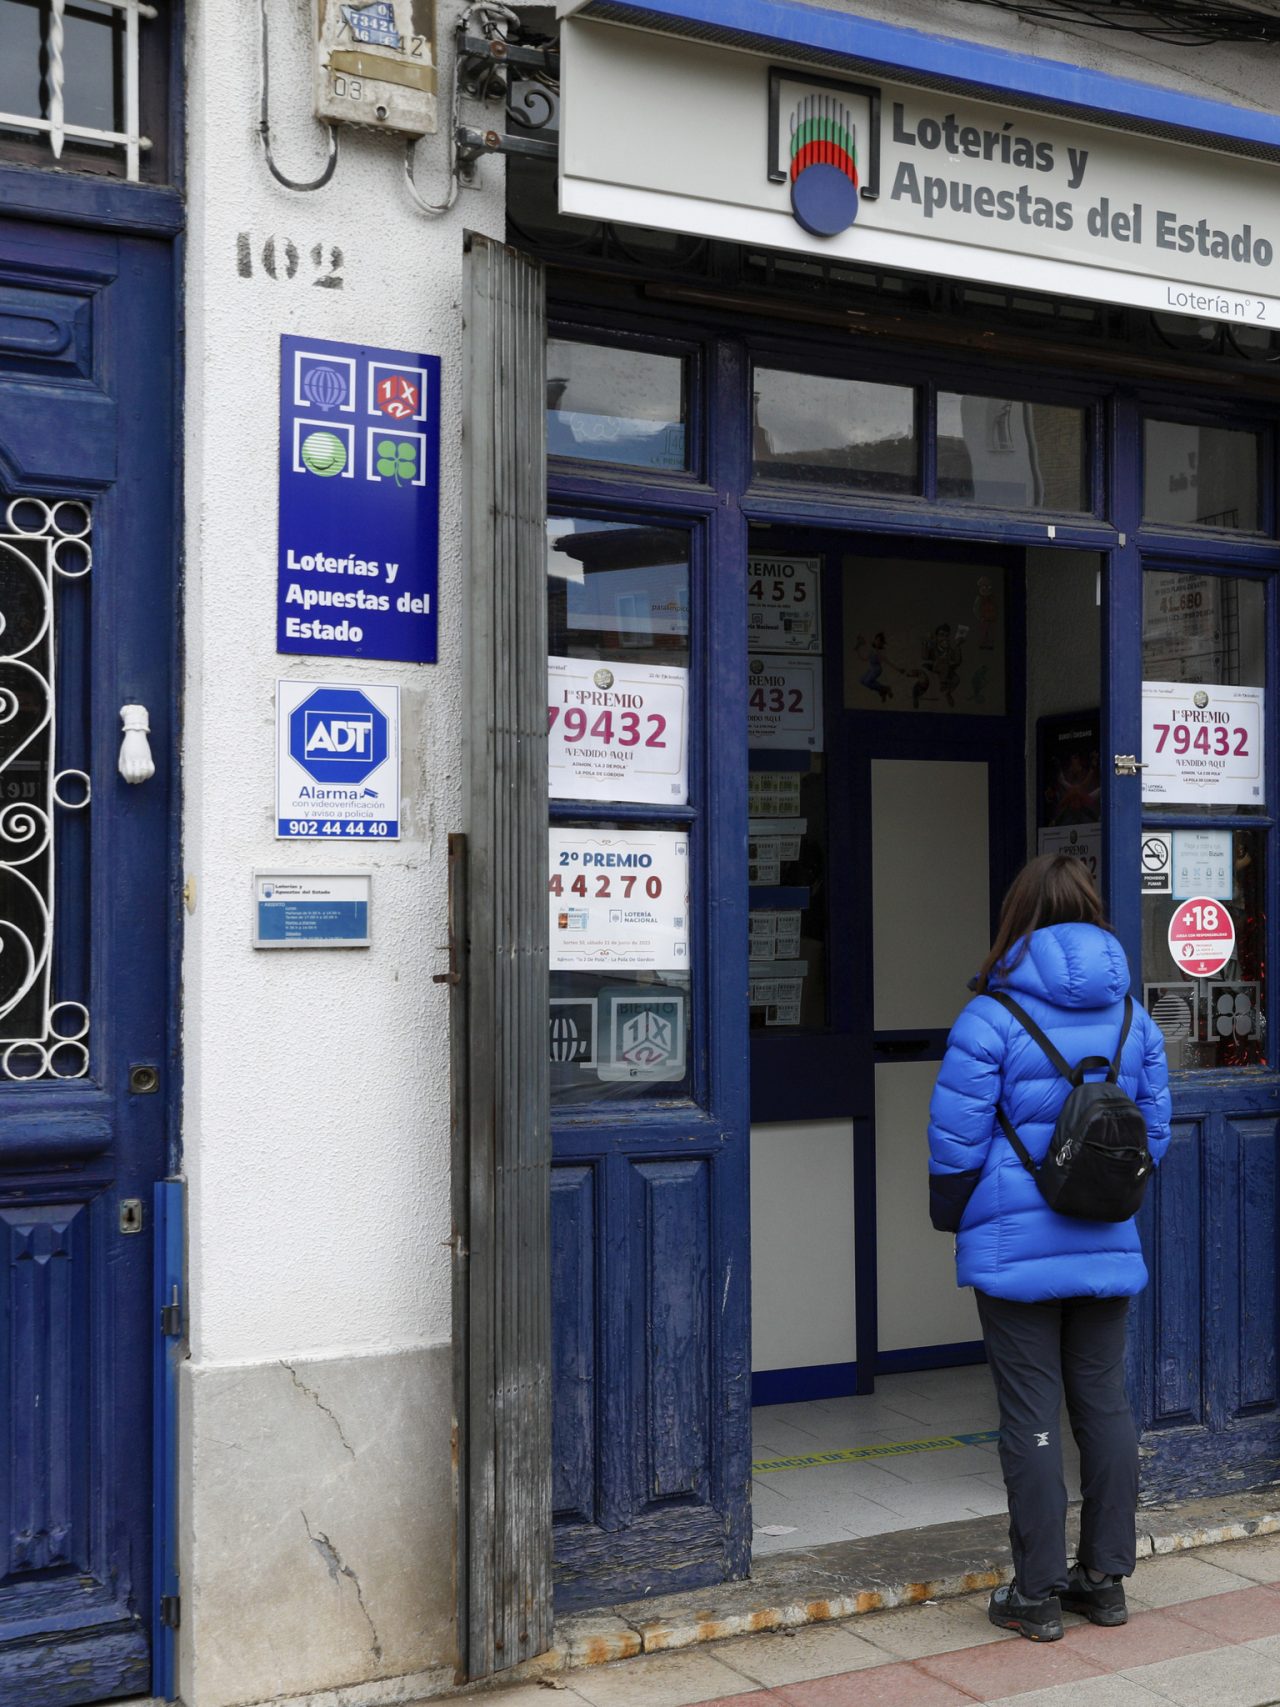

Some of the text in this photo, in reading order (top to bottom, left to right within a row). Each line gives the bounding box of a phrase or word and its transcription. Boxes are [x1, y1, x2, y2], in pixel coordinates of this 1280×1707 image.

[335, 77, 361, 100] 03
[893, 102, 1089, 189] Loterías y
[890, 161, 1273, 267] Apuestas del Estado
[236, 232, 344, 290] 102
[1167, 286, 1230, 315] Lotería
[1256, 300, 1266, 320] 2
[287, 549, 399, 584] Loterías y
[285, 584, 430, 614] Apuestas del
[286, 617, 363, 642] Estado
[576, 690, 643, 709] PREMIO
[548, 706, 666, 748] 79432
[1181, 710, 1230, 724] PREMIO
[306, 720, 371, 753] ADT
[1153, 724, 1249, 757] 79432
[565, 748, 607, 758] VENDIDO
[1175, 759, 1207, 768] VENDIDO
[292, 800, 385, 809] con videoverificación
[298, 786, 358, 800] Alarma
[289, 821, 388, 835] 902 44 44 40
[559, 851, 652, 868] 2º PREMIO
[548, 874, 662, 899] 44270
[1182, 905, 1219, 931] +18
[821, 1450, 846, 1461] DE
[849, 1439, 955, 1458] SEGURIDAD
